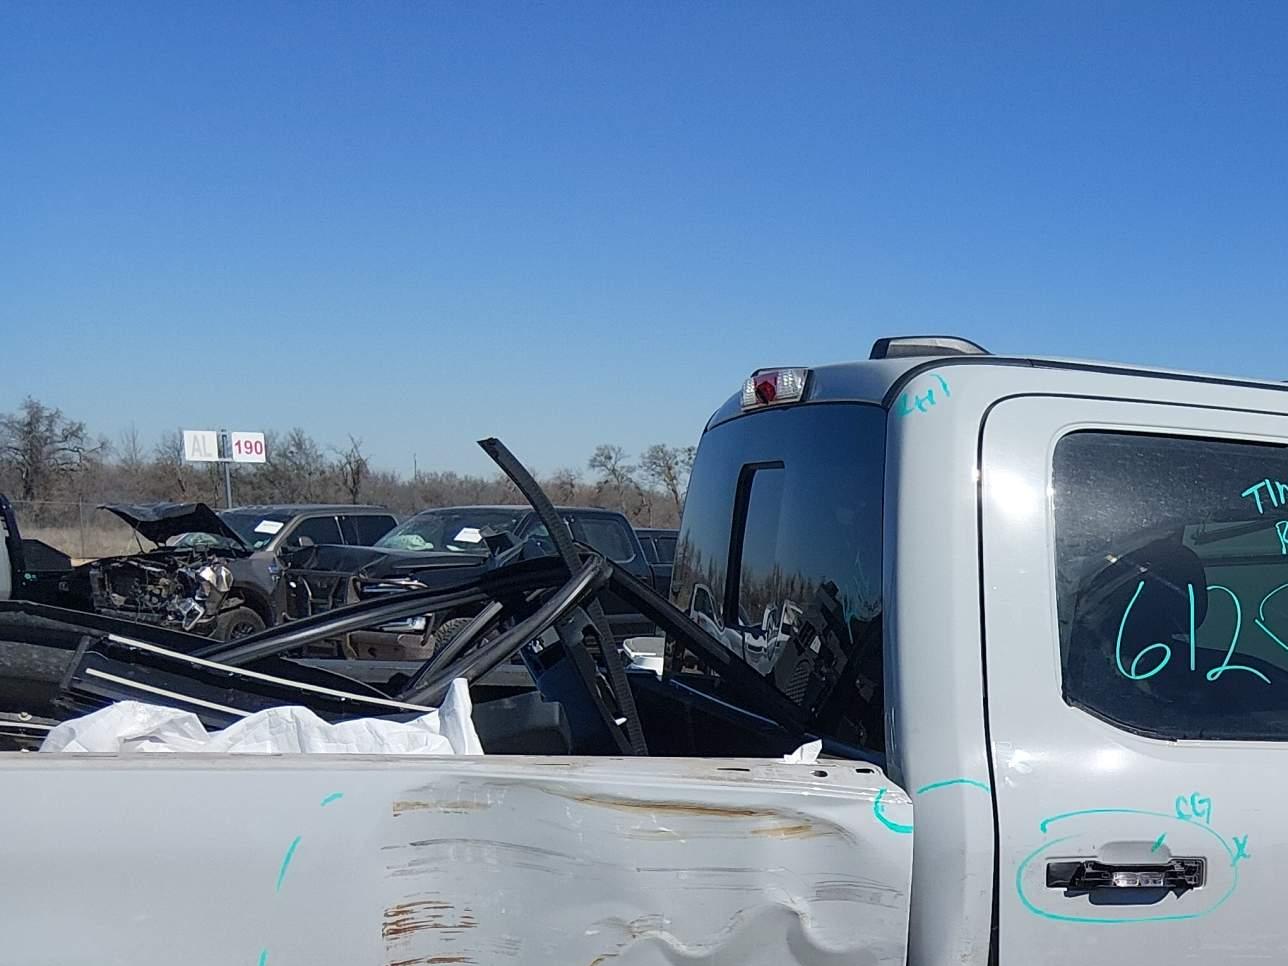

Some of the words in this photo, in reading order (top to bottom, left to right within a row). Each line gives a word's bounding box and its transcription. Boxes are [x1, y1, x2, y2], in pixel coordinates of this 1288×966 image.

[191, 433, 213, 457] AL
[234, 439, 264, 455] 190
[1116, 581, 1272, 685] 612
